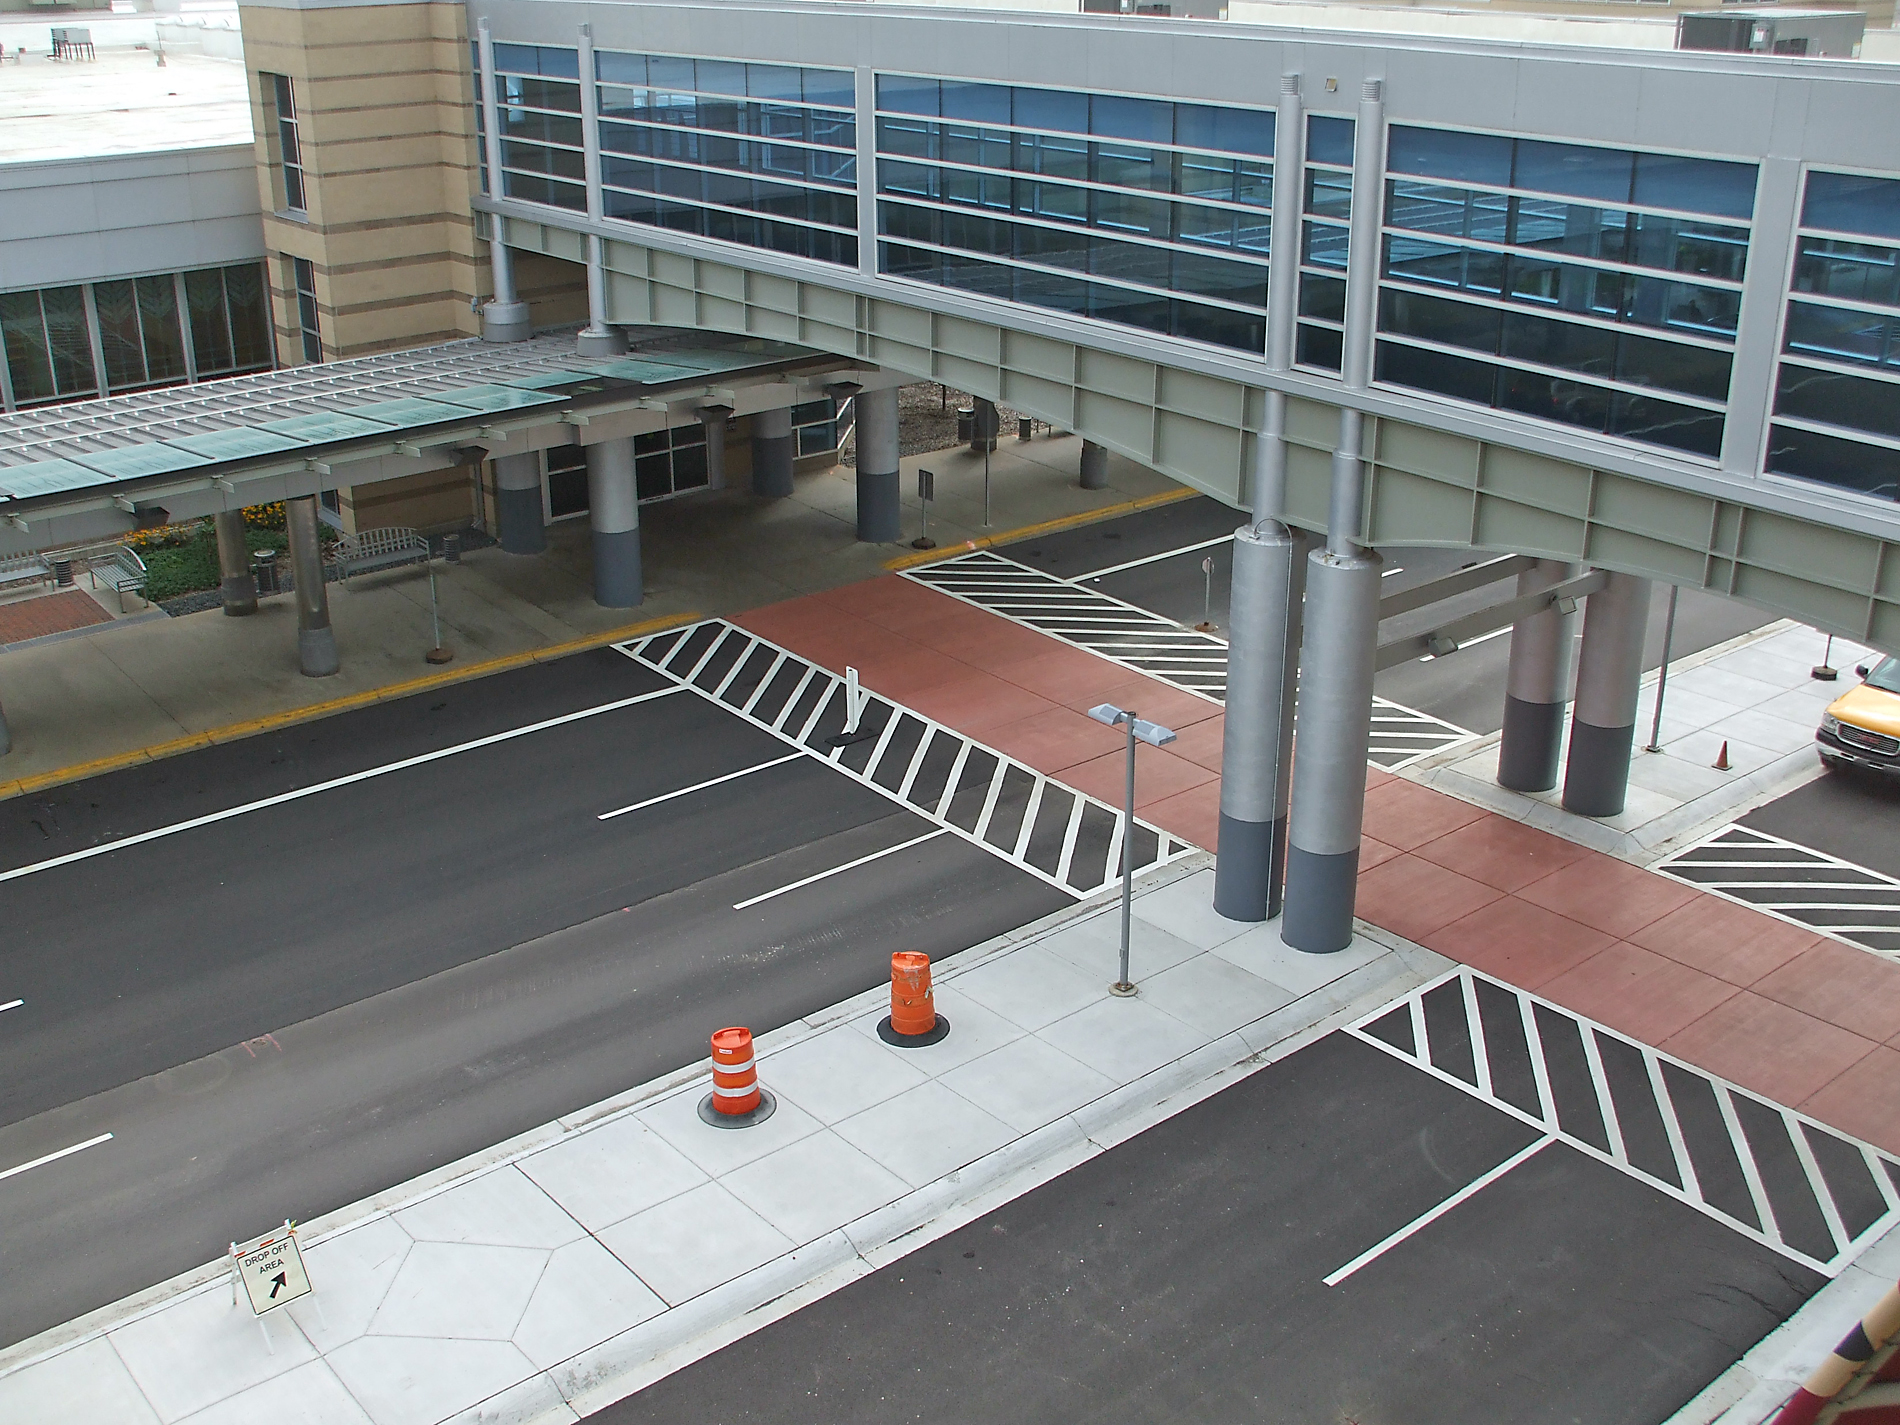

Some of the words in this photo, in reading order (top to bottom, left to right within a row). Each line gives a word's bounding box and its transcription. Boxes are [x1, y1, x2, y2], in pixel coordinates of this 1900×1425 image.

[244, 1250, 270, 1267] DROP
[271, 1242, 289, 1255] OFF
[259, 1258, 285, 1275] AREA
